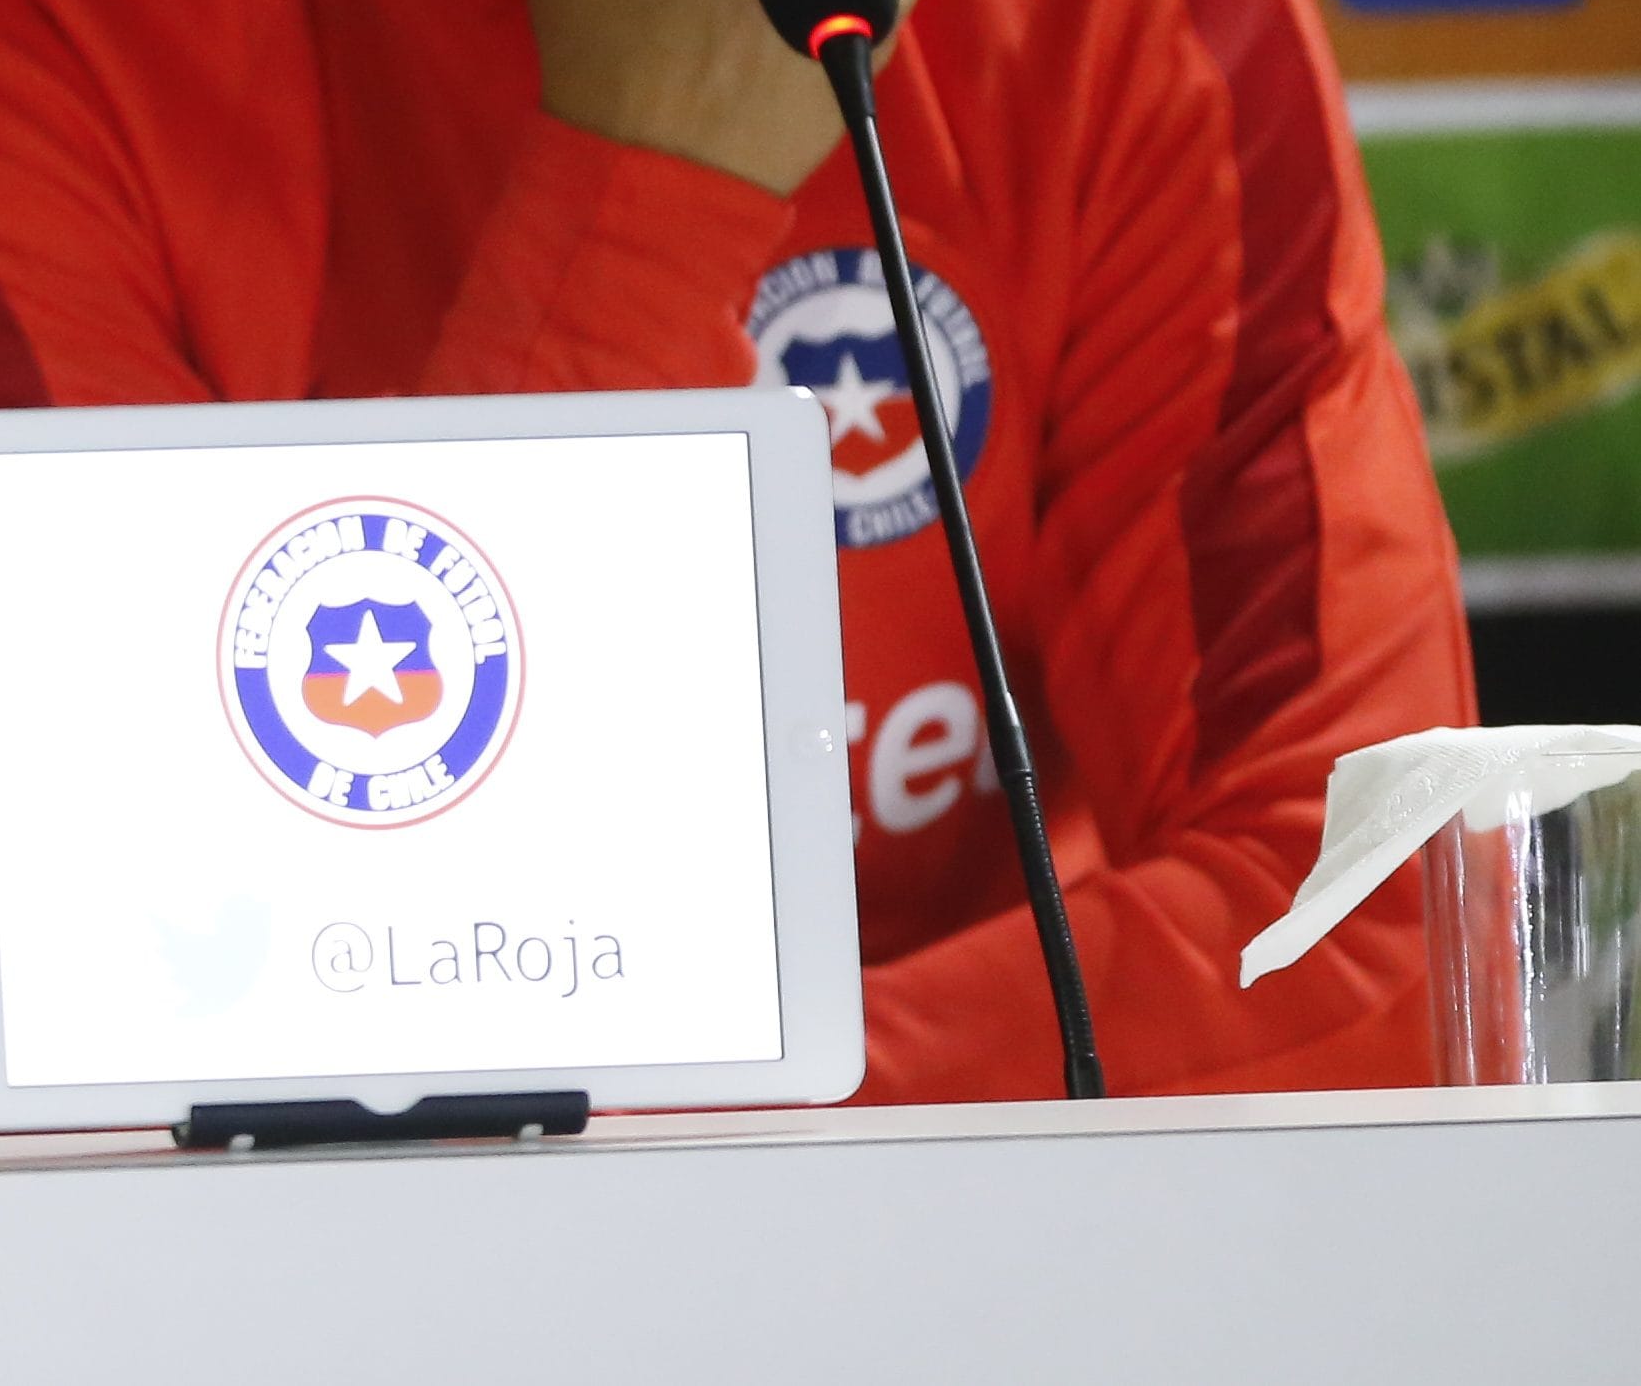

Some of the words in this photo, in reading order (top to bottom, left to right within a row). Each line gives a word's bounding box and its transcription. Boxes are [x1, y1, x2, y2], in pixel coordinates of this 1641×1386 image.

[234, 514, 367, 669] FEDERACION
[383, 516, 428, 563] DE
[429, 543, 508, 665] FUTBOL
[306, 761, 355, 808] DE
[368, 752, 457, 812] CHILE
[311, 920, 625, 999] @LaRoja
